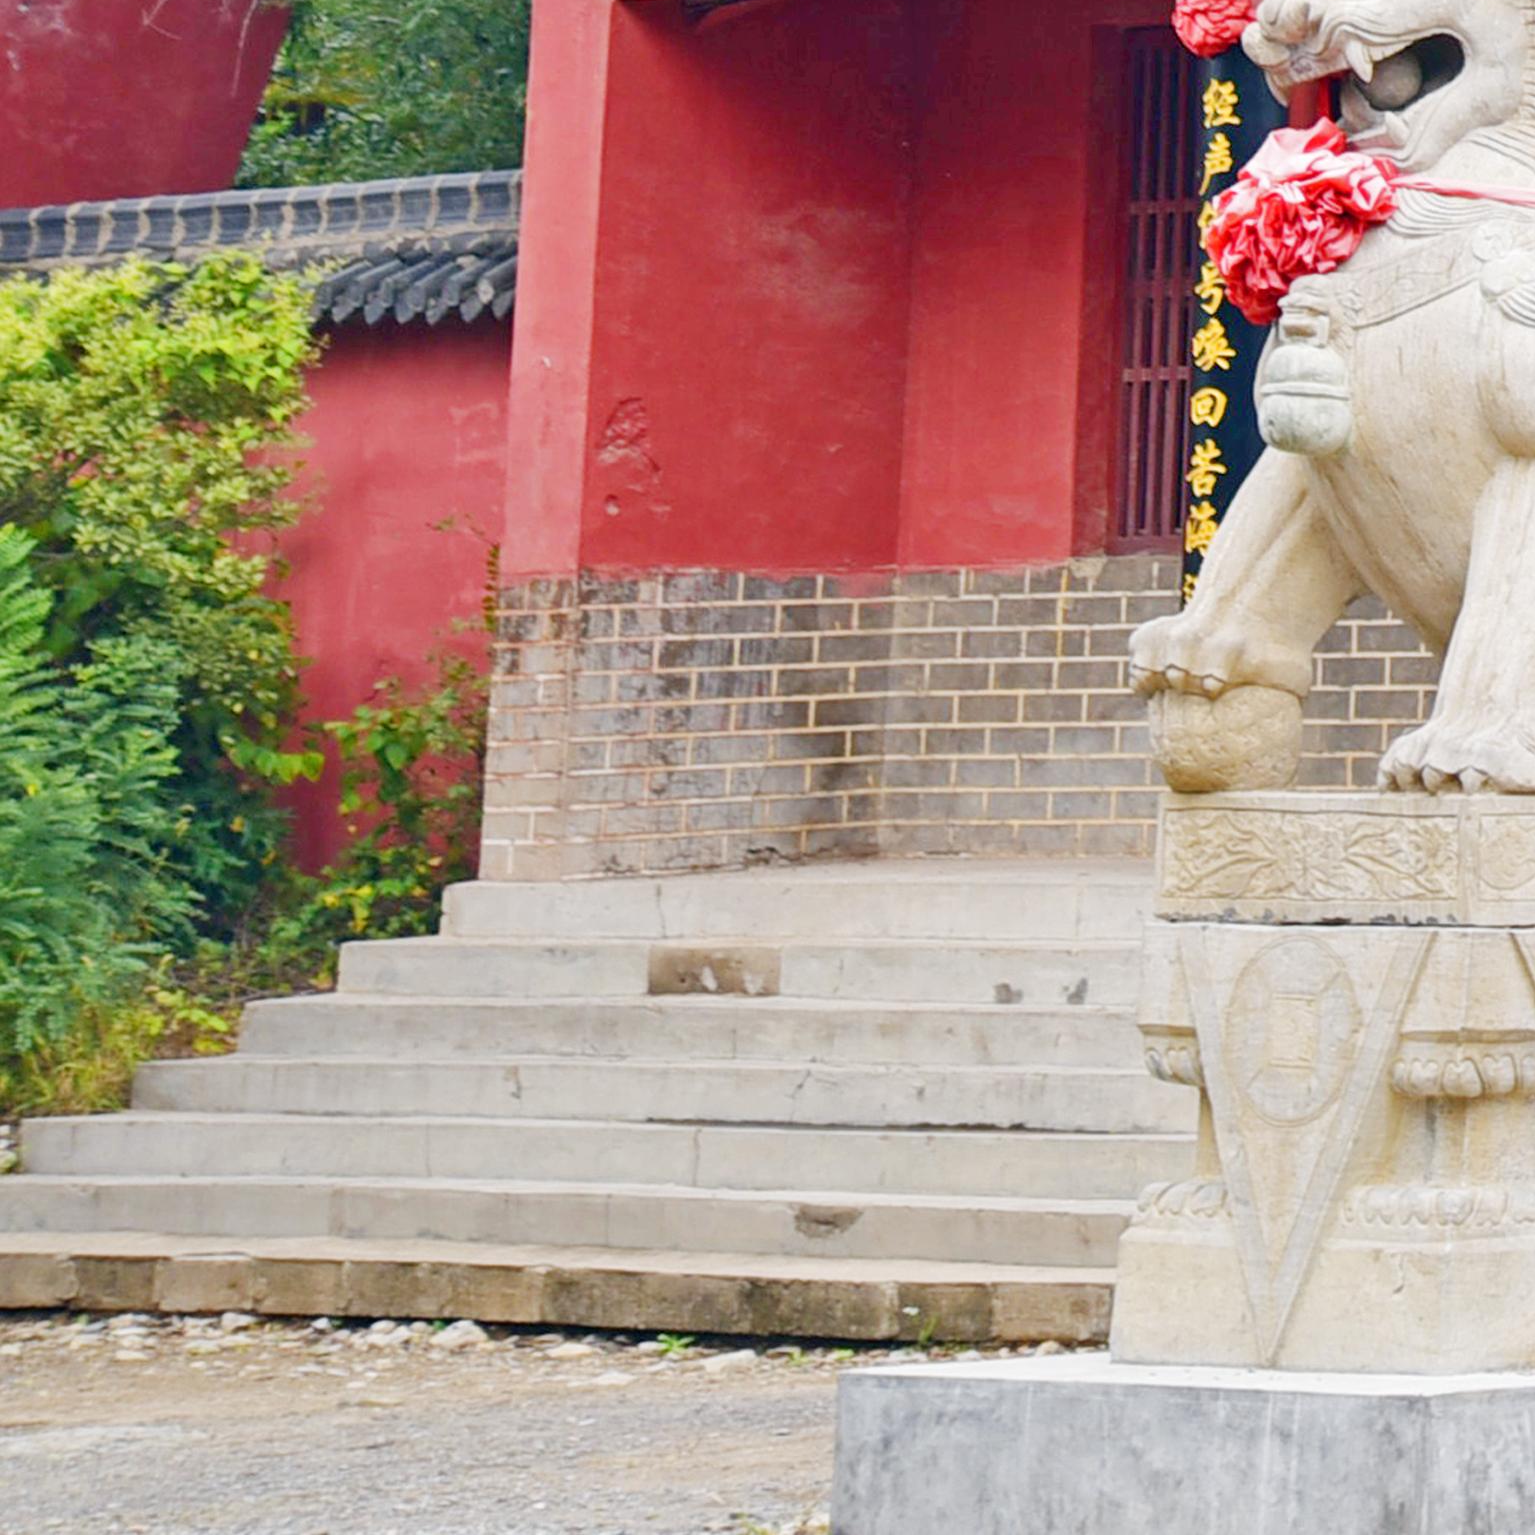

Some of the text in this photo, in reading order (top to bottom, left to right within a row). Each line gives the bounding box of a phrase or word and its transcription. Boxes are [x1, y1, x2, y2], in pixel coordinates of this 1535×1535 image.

[1183, 78, 1242, 604] 经声号唤回苦海
